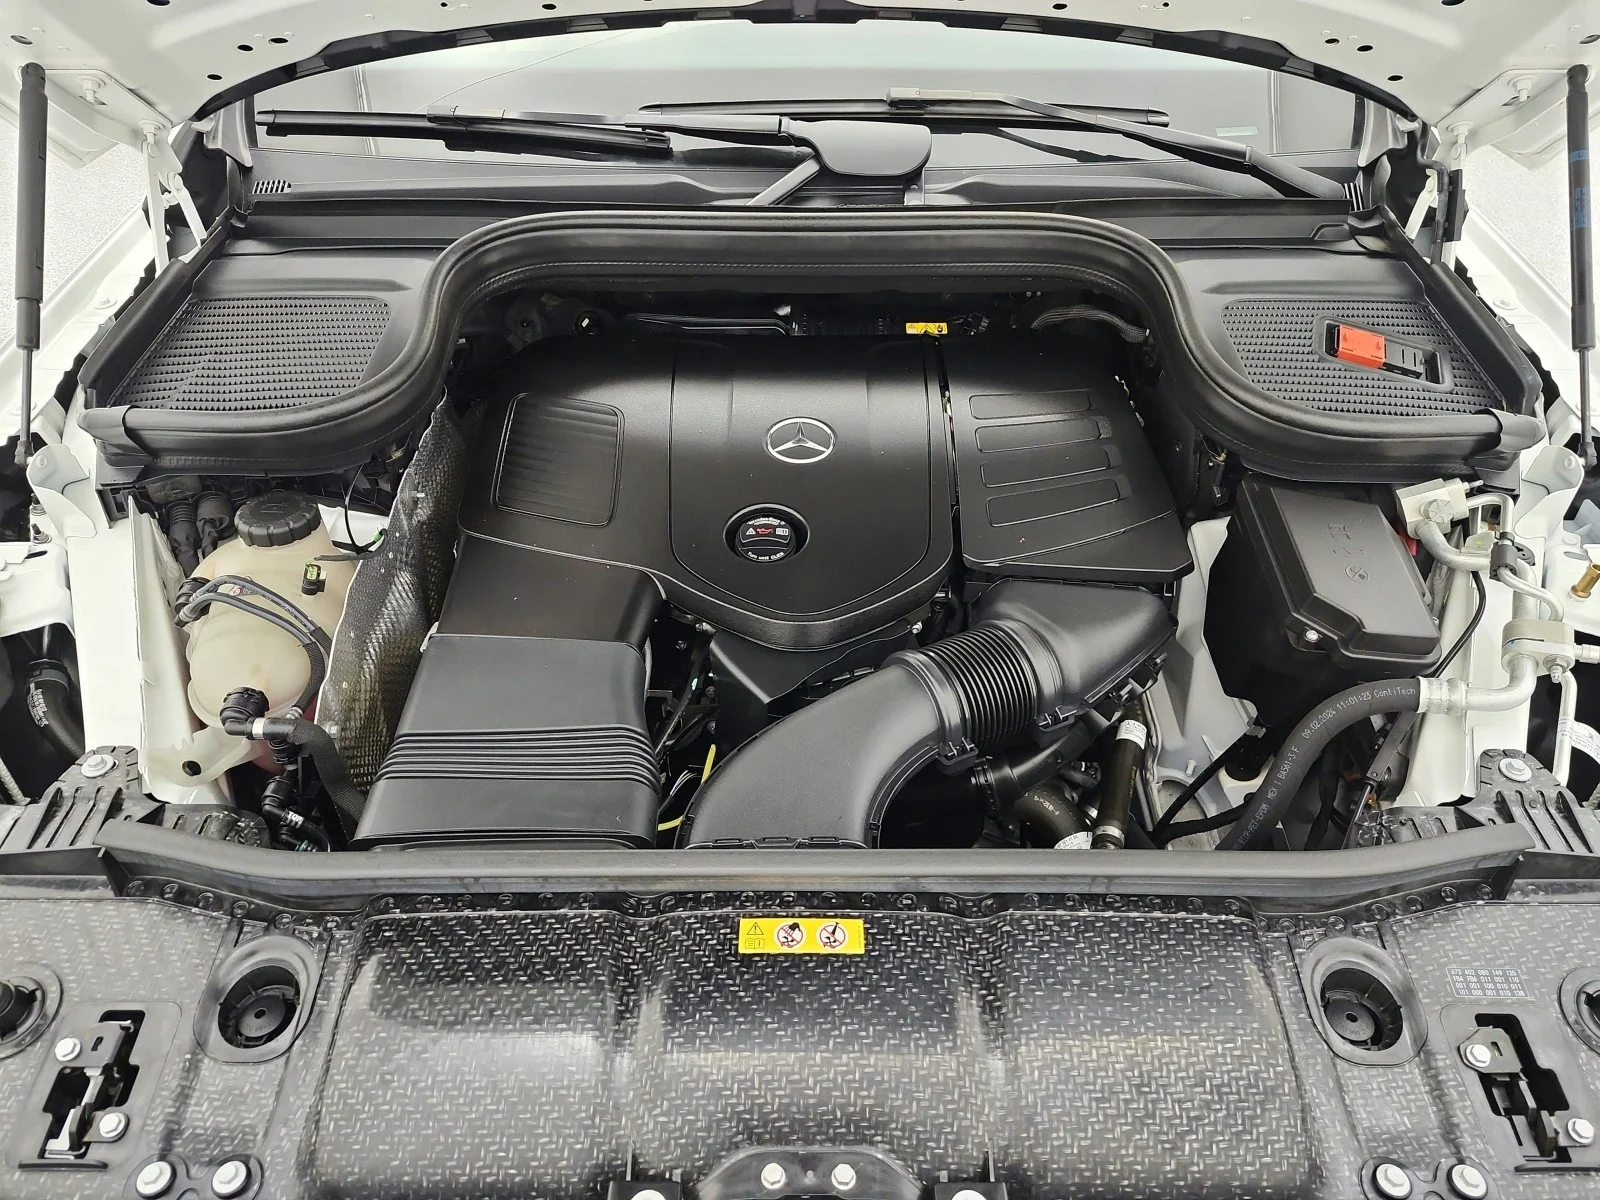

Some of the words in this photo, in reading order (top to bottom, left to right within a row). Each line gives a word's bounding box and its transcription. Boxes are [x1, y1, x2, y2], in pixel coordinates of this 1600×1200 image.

[1302, 708, 1336, 738] 09.02.2024
[1336, 692, 1371, 710] 11:01:23
[1373, 687, 1416, 698] ContiTech
